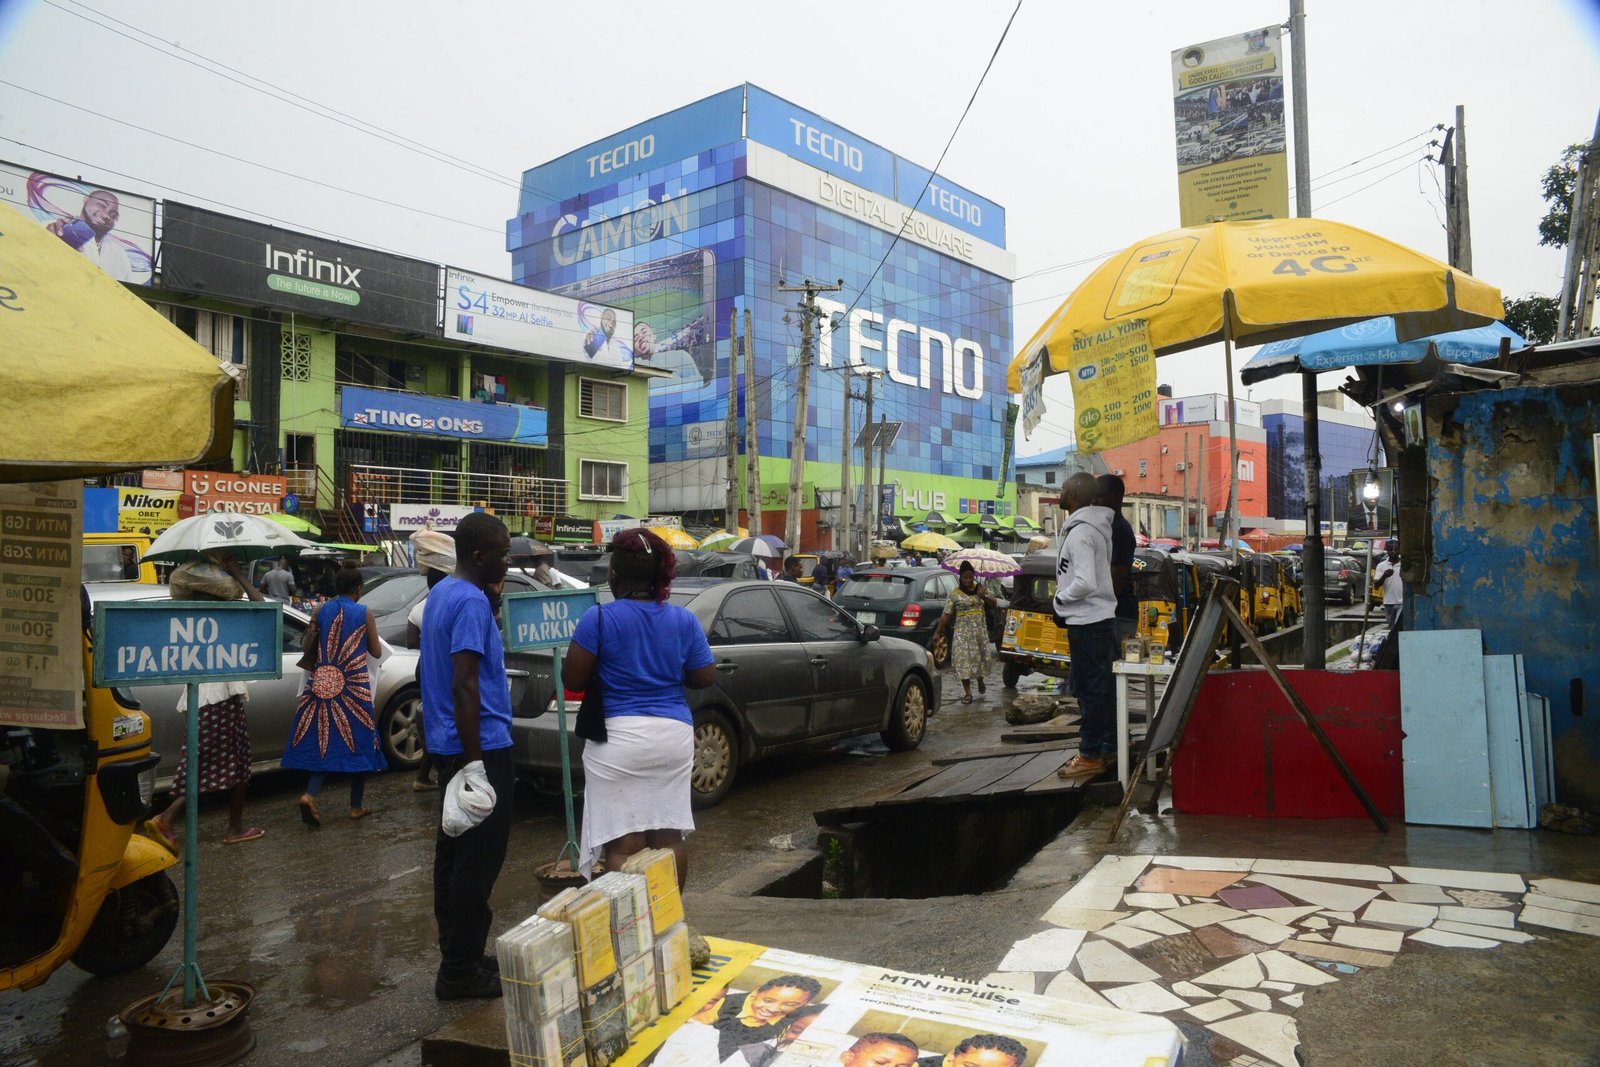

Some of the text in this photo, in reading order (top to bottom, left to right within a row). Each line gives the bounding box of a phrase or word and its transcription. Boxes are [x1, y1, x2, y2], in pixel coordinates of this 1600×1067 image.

[1189, 63, 1264, 86] GOOD CAUSES PROJECT
[586, 134, 655, 178] TECNO
[790, 117, 863, 173] TECNO
[819, 173, 973, 259] DIGITAL SQUARE
[928, 182, 982, 227] TECNO
[552, 188, 688, 266] CAMON
[1248, 232, 1322, 243] Upgrade
[1268, 247, 1328, 257] Device
[1296, 239, 1329, 248] SIM
[266, 243, 362, 288] Infinix
[448, 270, 475, 284] Infinix
[1272, 255, 1359, 276] 4G
[275, 278, 353, 303] The future is Now!
[457, 285, 489, 314] S4
[491, 293, 530, 310] Empower
[531, 315, 553, 328] Selfie
[1072, 318, 1147, 351] BUY ALL YOUR
[804, 293, 984, 401] TECNO
[1315, 349, 1409, 366] Experience More
[1101, 364, 1117, 378] 1000
[1130, 354, 1149, 367] 1500
[1103, 401, 1122, 413] 100
[1132, 390, 1152, 404] 200
[1104, 412, 1122, 424] 500
[1133, 401, 1152, 415] 1000
[364, 408, 422, 428] TING
[1080, 411, 1100, 427] glo
[214, 480, 282, 495] GIONEE
[123, 494, 175, 509] Nikon
[213, 499, 281, 515] CRYSTAL
[902, 488, 946, 511] HUB
[556, 524, 581, 533] Infinix
[542, 600, 569, 620] NO
[169, 616, 219, 644] NO
[517, 618, 580, 642] PARKIN
[117, 642, 259, 673] PARKING
[879, 973, 931, 989] MTN
[935, 984, 1021, 1006] mPulse
